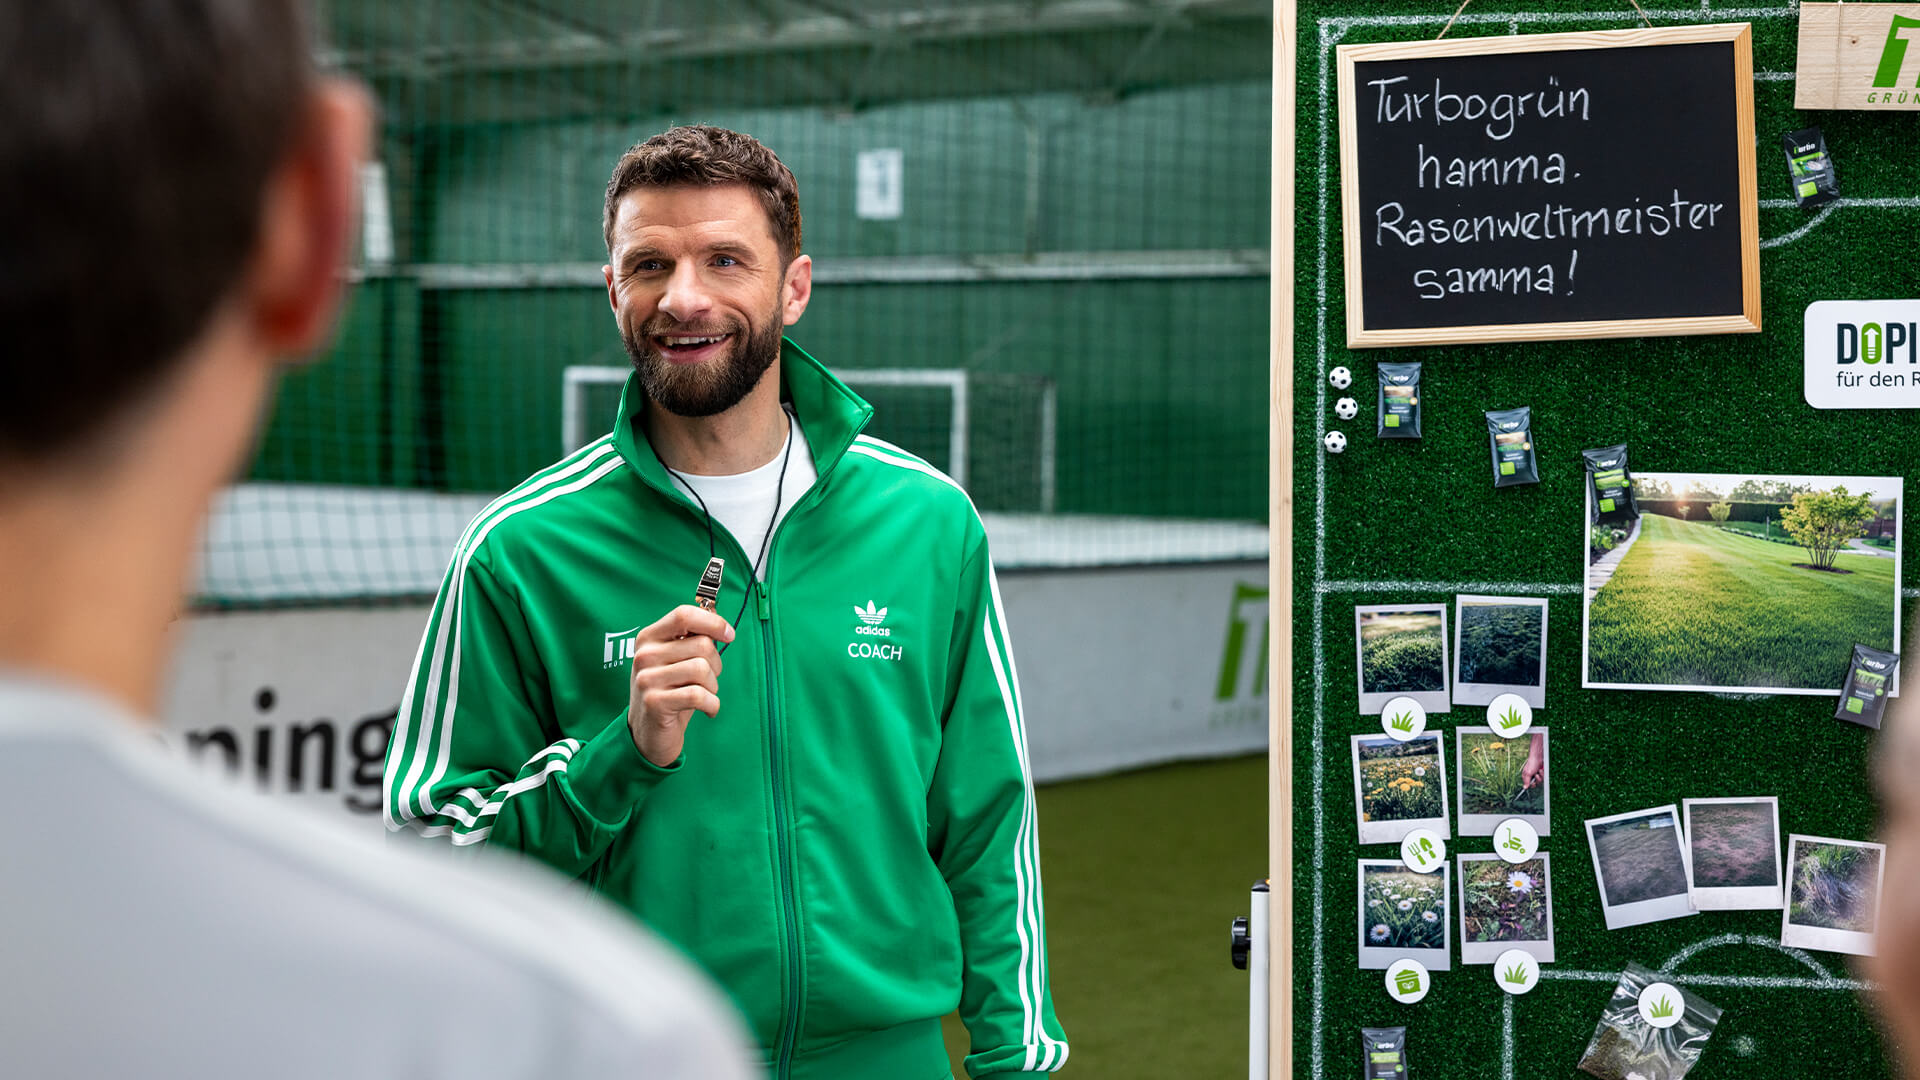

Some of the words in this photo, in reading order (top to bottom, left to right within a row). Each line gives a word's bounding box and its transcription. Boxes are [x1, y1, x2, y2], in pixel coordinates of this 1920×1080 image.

[1367, 75, 1590, 141] Turbogrün
[1417, 143, 1582, 189] hamma.
[1375, 188, 1724, 247] Rasenweltmeister
[1837, 322, 1917, 365] DOPI
[1836, 370, 1864, 387] für
[1869, 370, 1905, 387] den
[847, 642, 903, 661] COACH
[855, 625, 891, 637] adidas
